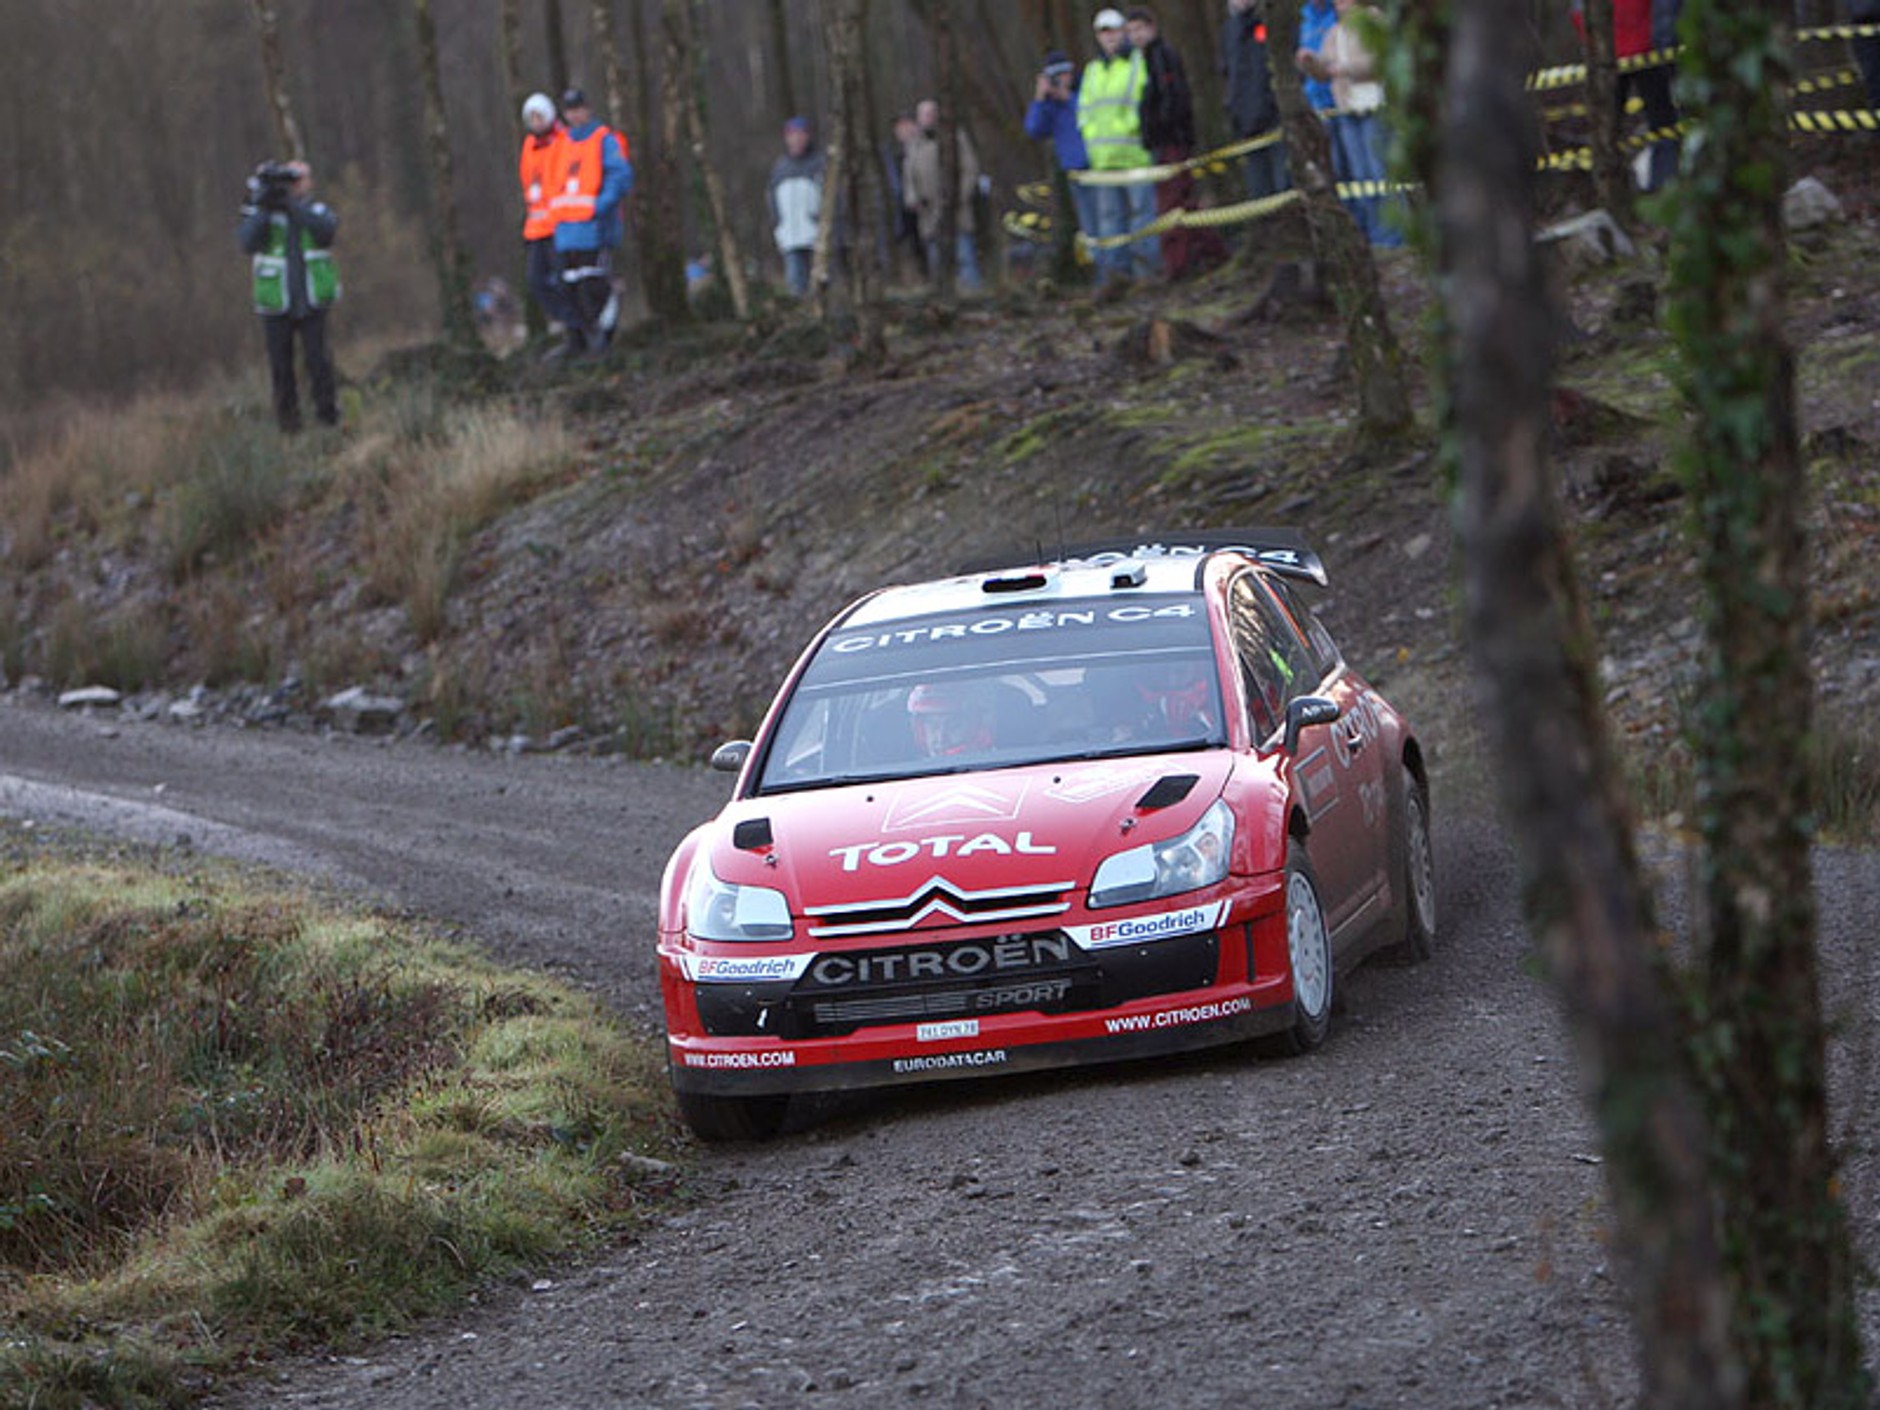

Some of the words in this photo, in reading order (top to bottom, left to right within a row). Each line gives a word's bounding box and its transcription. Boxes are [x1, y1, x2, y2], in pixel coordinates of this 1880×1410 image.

[832, 610, 1094, 652] CITROËN
[1107, 603, 1196, 622] C4
[829, 831, 1057, 872] TOTAL
[1090, 909, 1205, 942] BFGoodrich
[698, 958, 796, 975] BFGoodrich
[812, 934, 1071, 985] CITROËN
[975, 977, 1072, 1009] SPORT
[1104, 997, 1251, 1033] WWW.CITROEN.COM
[893, 1049, 1006, 1073] EURODATACAR
